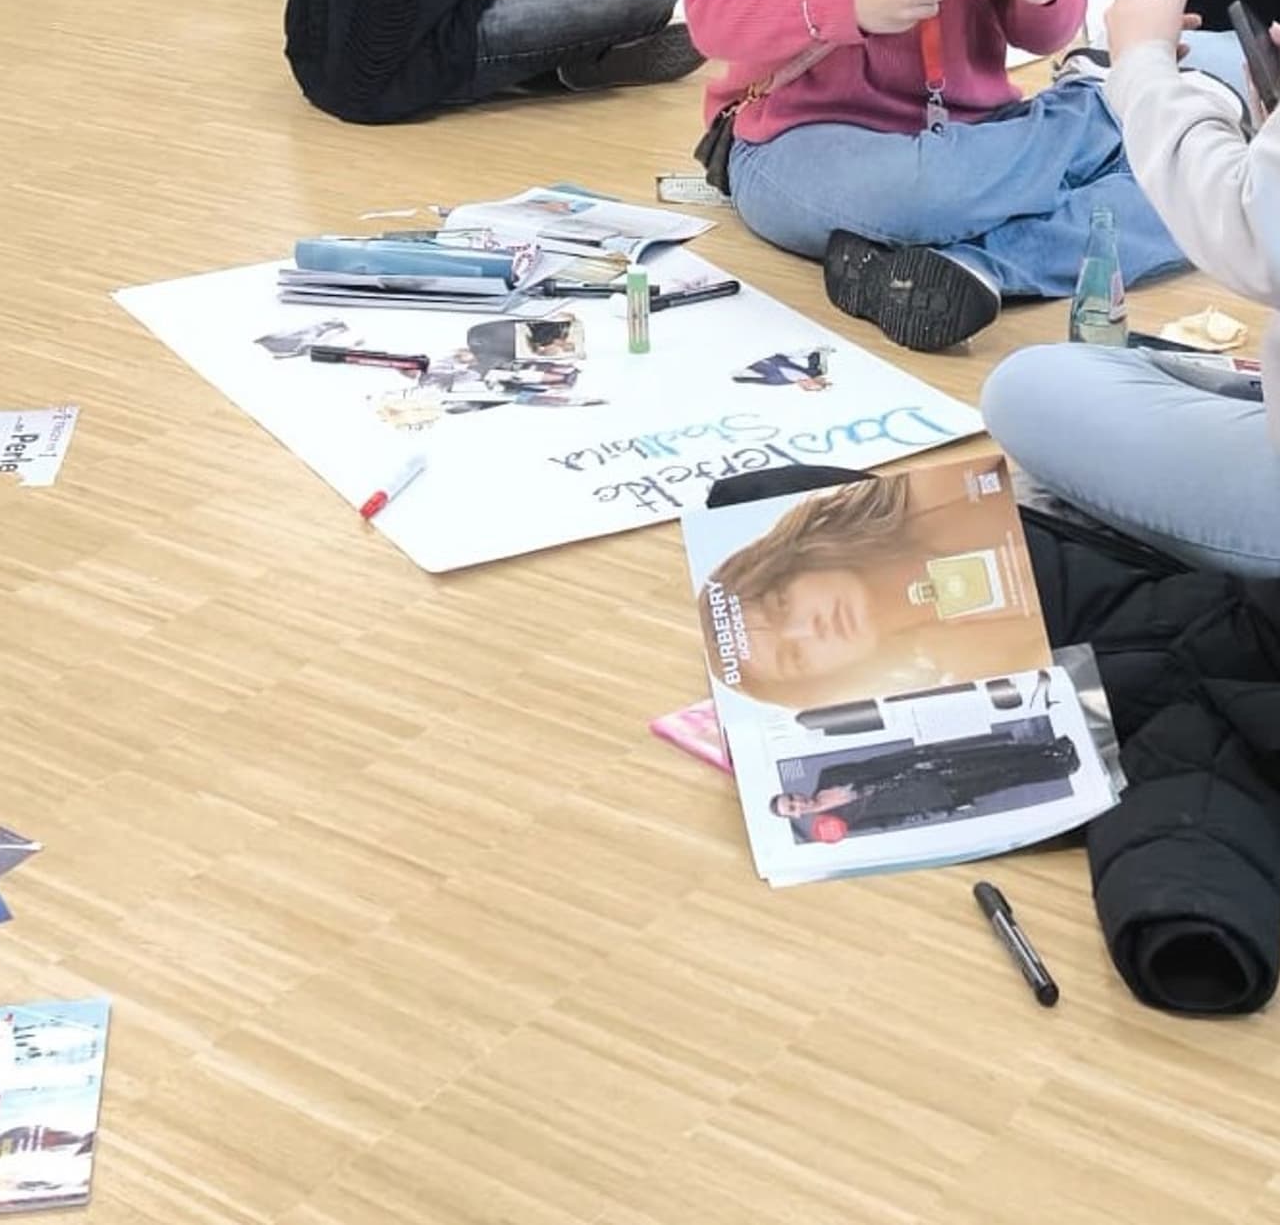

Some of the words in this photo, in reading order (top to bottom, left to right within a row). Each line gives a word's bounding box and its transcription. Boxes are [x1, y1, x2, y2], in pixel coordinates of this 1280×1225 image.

[789, 406, 957, 454] Das
[705, 579, 741, 685] BURBERRY
[728, 594, 752, 661] GODDESS
